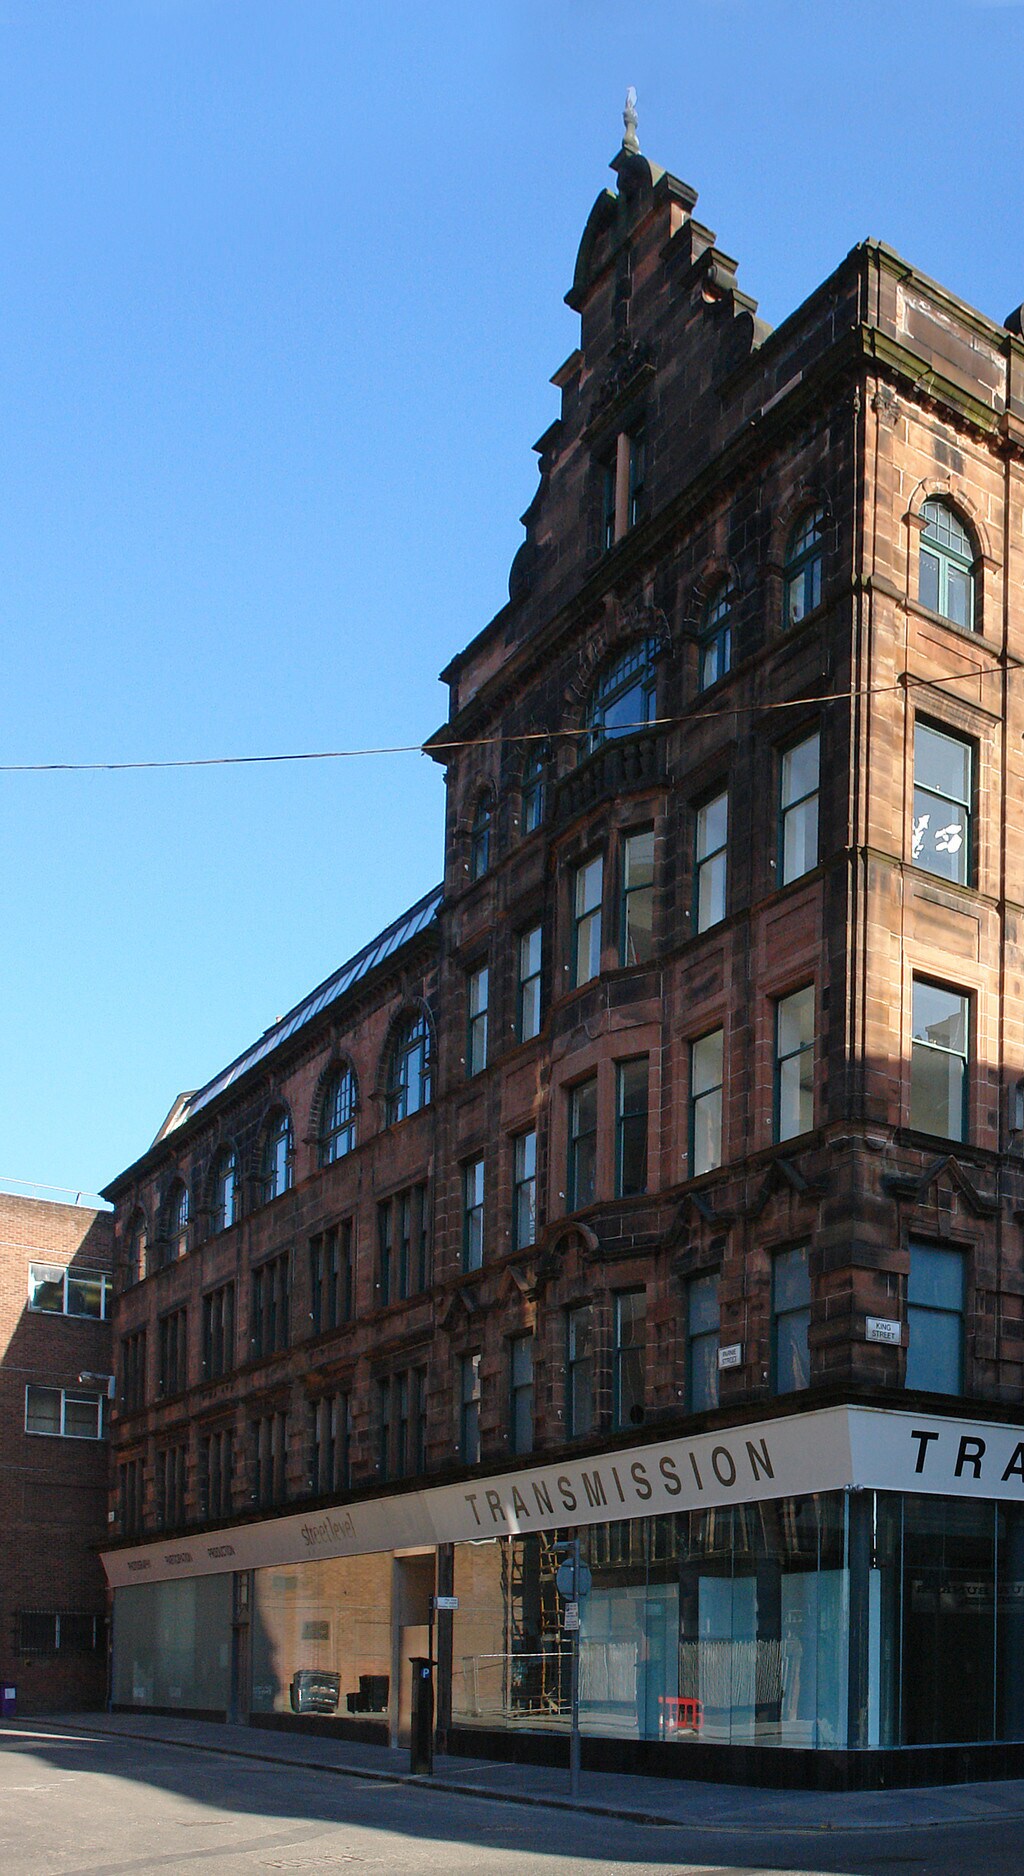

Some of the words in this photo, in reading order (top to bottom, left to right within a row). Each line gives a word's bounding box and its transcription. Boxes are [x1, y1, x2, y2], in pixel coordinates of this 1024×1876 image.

[876, 1322, 891, 1332] KING
[872, 1330, 895, 1340] STREET
[721, 1355, 737, 1366] STREET
[464, 1438, 775, 1526] TRANSMISSION
[422, 1667, 430, 1679] P
